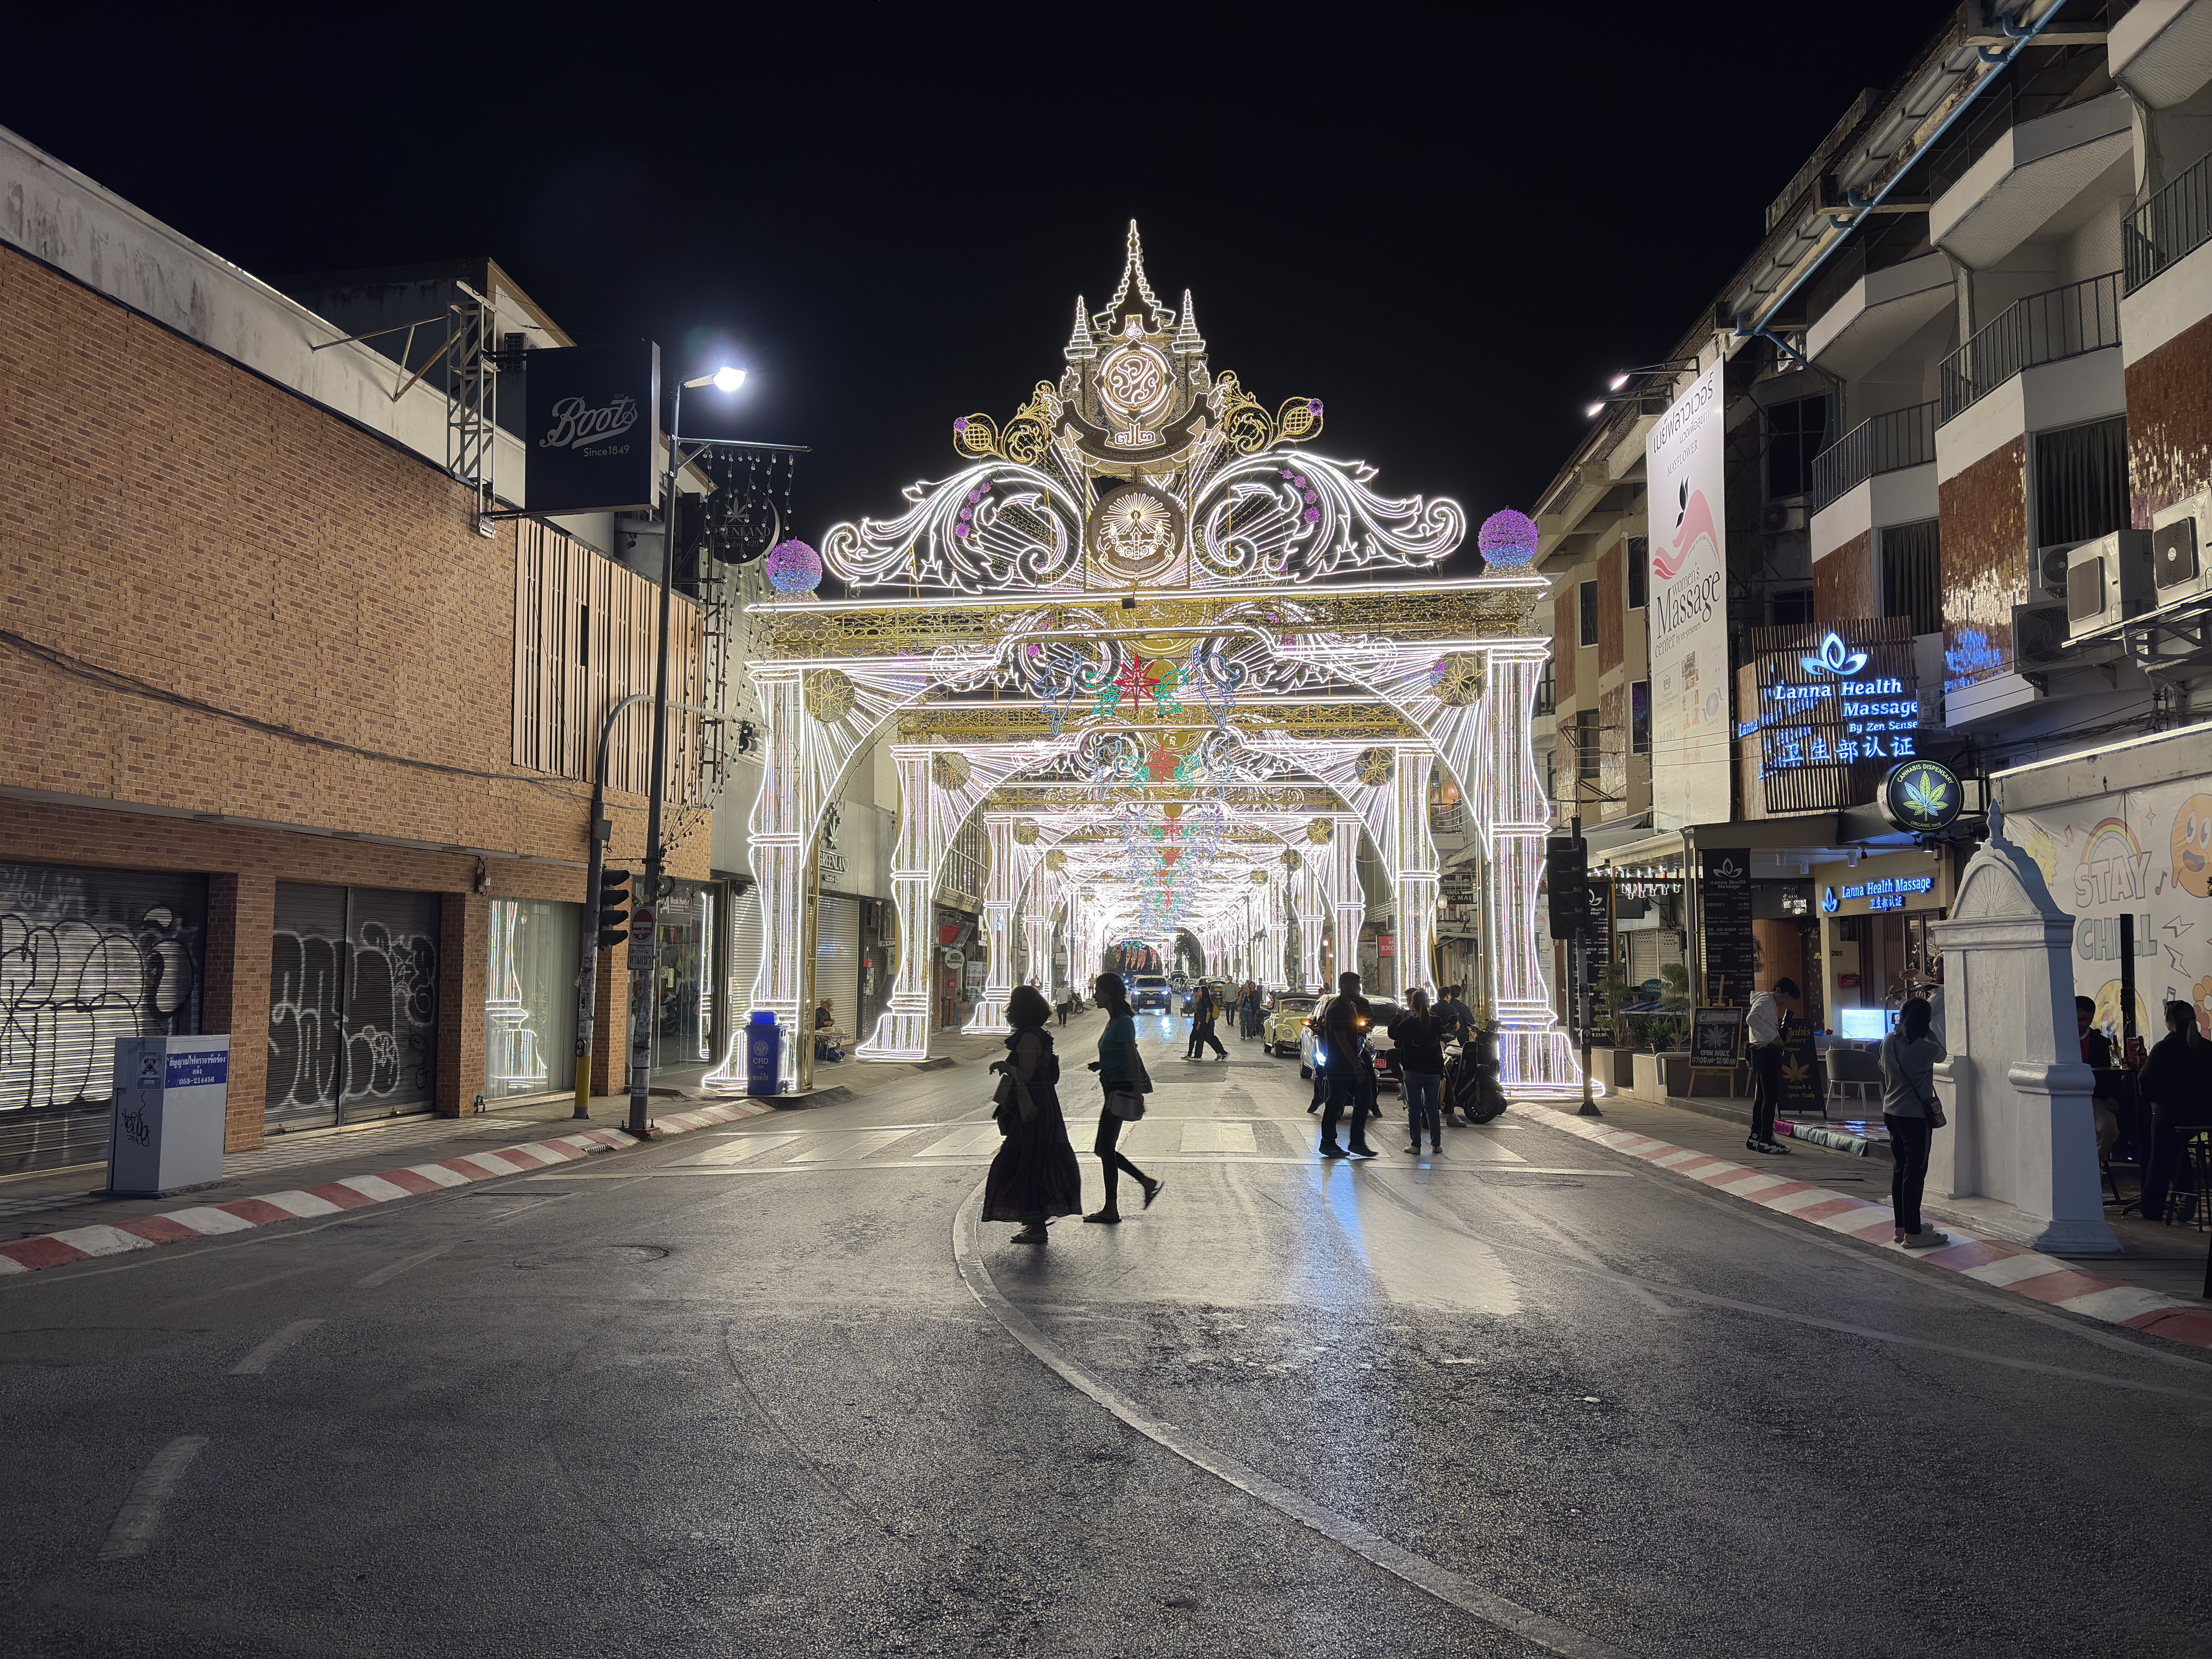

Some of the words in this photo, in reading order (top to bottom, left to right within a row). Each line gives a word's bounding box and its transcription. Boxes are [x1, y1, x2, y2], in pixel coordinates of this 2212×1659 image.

[539, 396, 638, 450] Boots
[1667, 440, 1698, 477] MAYFLOWER
[1672, 562, 1700, 596] women's
[1656, 571, 1720, 640] Massage
[1655, 634, 1675, 658] center
[1775, 685, 1832, 700] Lanna
[1841, 679, 1903, 696] Health
[1843, 701, 1918, 718] Massage
[1739, 719, 1759, 737] Lanna
[1849, 723, 1862, 734] By
[1866, 722, 1886, 732] Zen
[1888, 720, 1918, 730] Sense
[1782, 735, 1917, 763] 卫生部认证
[1897, 764, 1922, 782] CANNABIS
[1923, 764, 1954, 784] DISPENSARY
[819, 851, 849, 872] GREENLAND
[1842, 886, 1864, 898] Lanna
[1867, 879, 1893, 895] Health
[1895, 878, 1931, 893] Massage
[2074, 851, 2152, 908] STAY
[1870, 895, 1902, 911] 卫生部认证
[179, 1076, 215, 1085] 053-214456
[192, 1066, 202, 1074] แจ้ง
